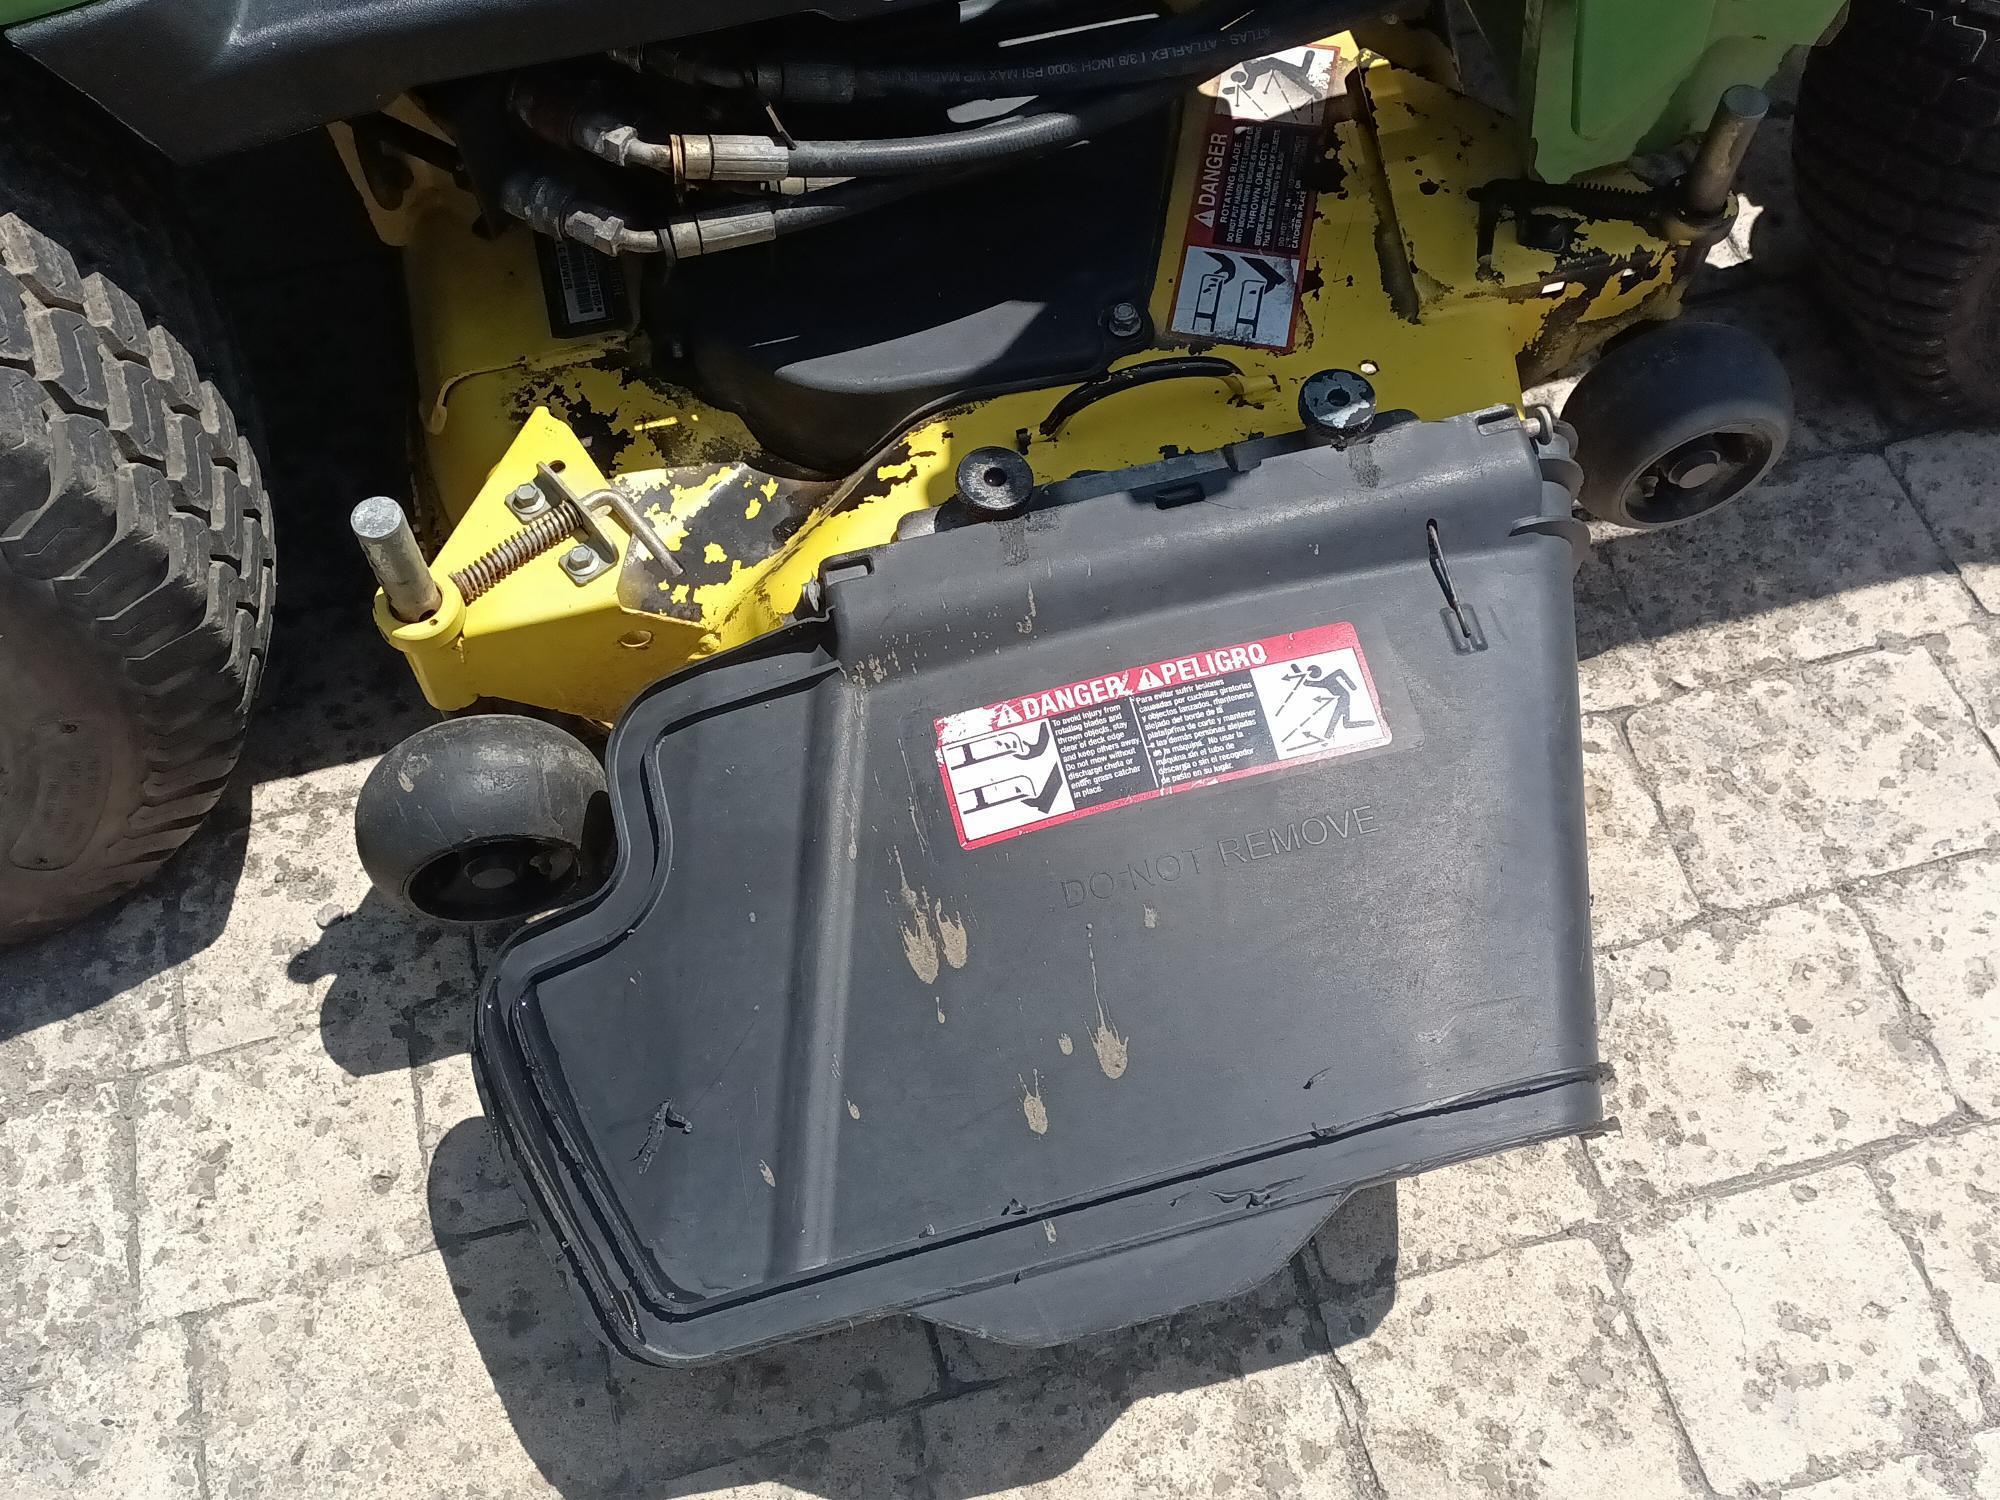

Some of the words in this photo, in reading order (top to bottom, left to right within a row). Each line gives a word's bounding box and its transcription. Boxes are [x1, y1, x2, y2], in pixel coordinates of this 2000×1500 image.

[1081, 57, 1114, 72] INCH
[1197, 133, 1228, 206] DANGER
[1237, 173, 1245, 182] OR
[1219, 175, 1235, 223] ROTATING
[1229, 141, 1241, 173] BLADE
[1246, 187, 1261, 229] THROWN
[1255, 142, 1269, 185] OBJECTS
[1242, 184, 1251, 202] WHEN
[1231, 205, 1239, 218] PUT
[1237, 204, 1248, 227] MOWER
[1254, 222, 1264, 245] BEFORE
[1263, 176, 1272, 196] CLEAR
[1268, 207, 1275, 215] BE
[1289, 218, 1302, 248] CATCHER
[1296, 191, 1307, 210] PLACE
[1228, 218, 1236, 231] NOT
[1265, 216, 1273, 229] MAY
[1226, 232, 1234, 242] DO
[1235, 228, 1243, 243] INTO
[1262, 230, 1271, 246] THAT
[1160, 643, 1267, 686] PELIGRO
[1020, 676, 1127, 720] DANGER
[1135, 695, 1153, 704] Para
[1154, 690, 1173, 700] evitar
[1175, 685, 1193, 695] sufrir
[1194, 679, 1224, 690] lesiones
[1139, 700, 1172, 713] causadas
[1173, 697, 1185, 706] por
[1187, 690, 1218, 701] cuchillas
[1219, 682, 1252, 696] giratorias
[1062, 713, 1081, 724] avoid
[1082, 709, 1102, 719] injury
[1103, 704, 1121, 713] from
[1141, 715, 1146, 723] y
[1178, 701, 1212, 713] lanzados,
[1213, 691, 1254, 705] mantenerse
[1055, 723, 1082, 736] rotating
[1083, 717, 1107, 728] blades
[1108, 712, 1122, 722] and
[1144, 719, 1170, 730] alejado
[1171, 715, 1183, 724] del
[1183, 711, 1204, 721] borde
[1147, 725, 1186, 741] plataforma
[1197, 718, 1216, 727] corte
[1222, 709, 1256, 722] mantener
[1193, 726, 1226, 739] personas
[1227, 719, 1256, 730] alejadas
[1057, 733, 1082, 744] thrown
[1084, 726, 1112, 737] objects,
[1112, 722, 1127, 730] stay
[1060, 743, 1078, 753] clear
[1078, 740, 1087, 748] of
[1088, 736, 1106, 746] deck
[1106, 732, 1124, 741] edge
[1219, 733, 1235, 741] usar
[1063, 752, 1076, 762] and
[1077, 749, 1095, 758] keep
[1096, 743, 1119, 753] others
[1120, 737, 1141, 747] away.
[1076, 759, 1089, 768] not
[1090, 755, 1107, 764] mow
[1108, 747, 1136, 759] without
[1198, 758, 1210, 766] sin
[1210, 755, 1218, 763] el
[1218, 748, 1254, 761] recogedor
[1207, 745, 1224, 753] tubo
[1068, 766, 1103, 780] discharge
[1093, 773, 1113, 784] grass
[1114, 765, 1140, 777] catcher
[1161, 776, 1171, 784] de
[1060, 872, 1114, 909] DO
[1127, 846, 1204, 890] NOT
[1217, 805, 1379, 867] REMOVE
